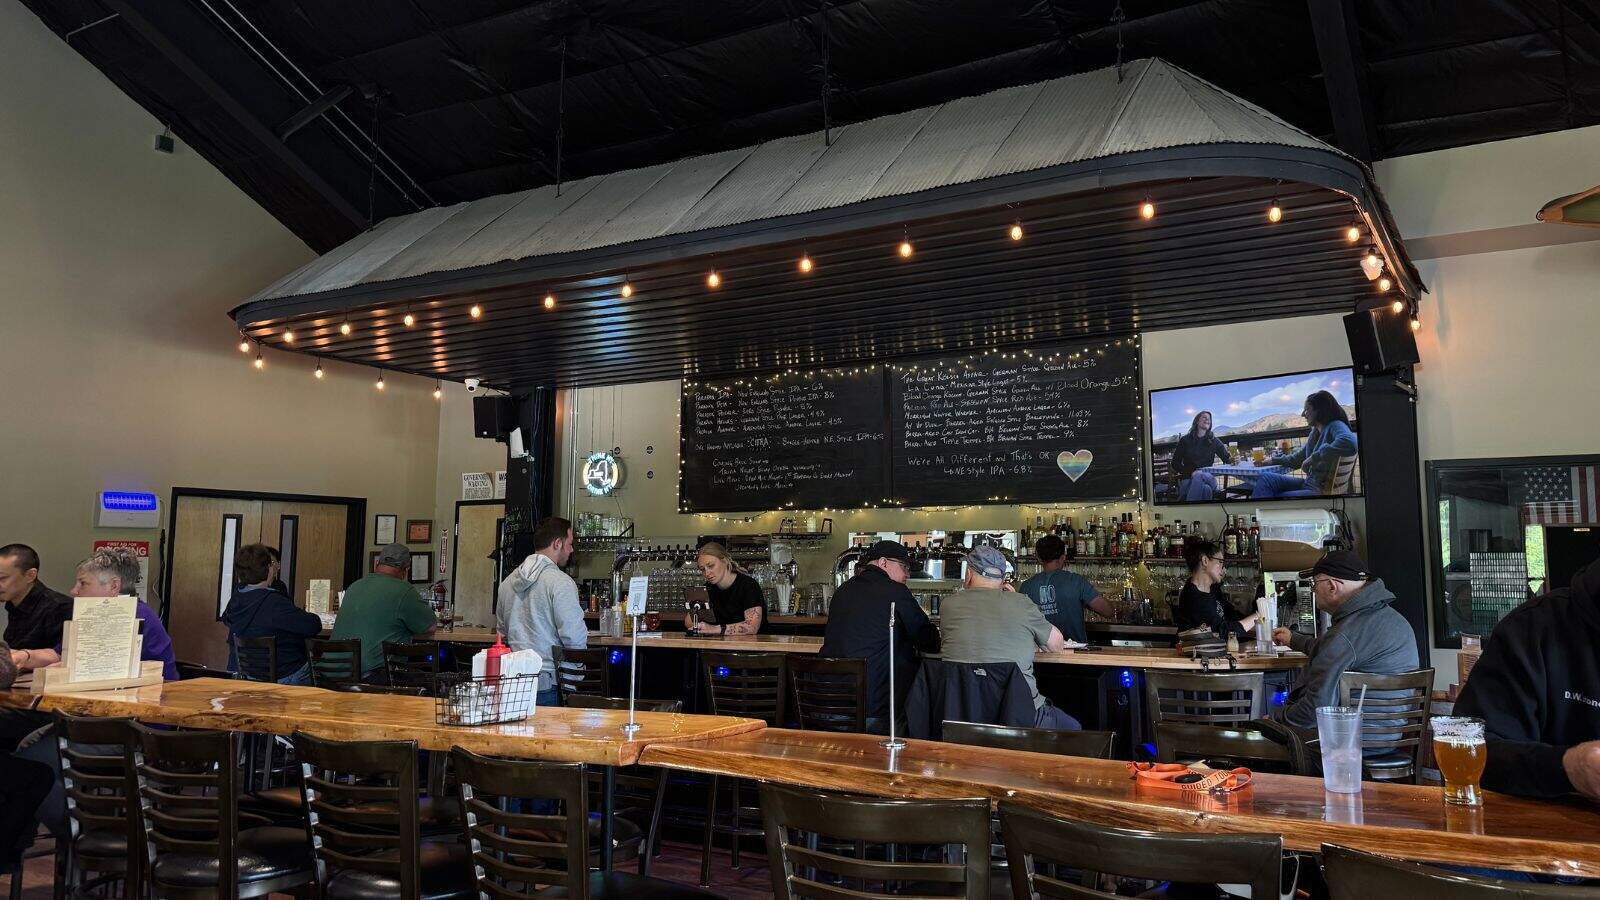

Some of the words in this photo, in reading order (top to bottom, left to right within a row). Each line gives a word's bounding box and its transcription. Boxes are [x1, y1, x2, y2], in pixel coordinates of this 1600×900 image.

[951, 453, 992, 464] Different
[990, 465, 1005, 475] IPA
[1181, 779, 1212, 789] GUIDED
